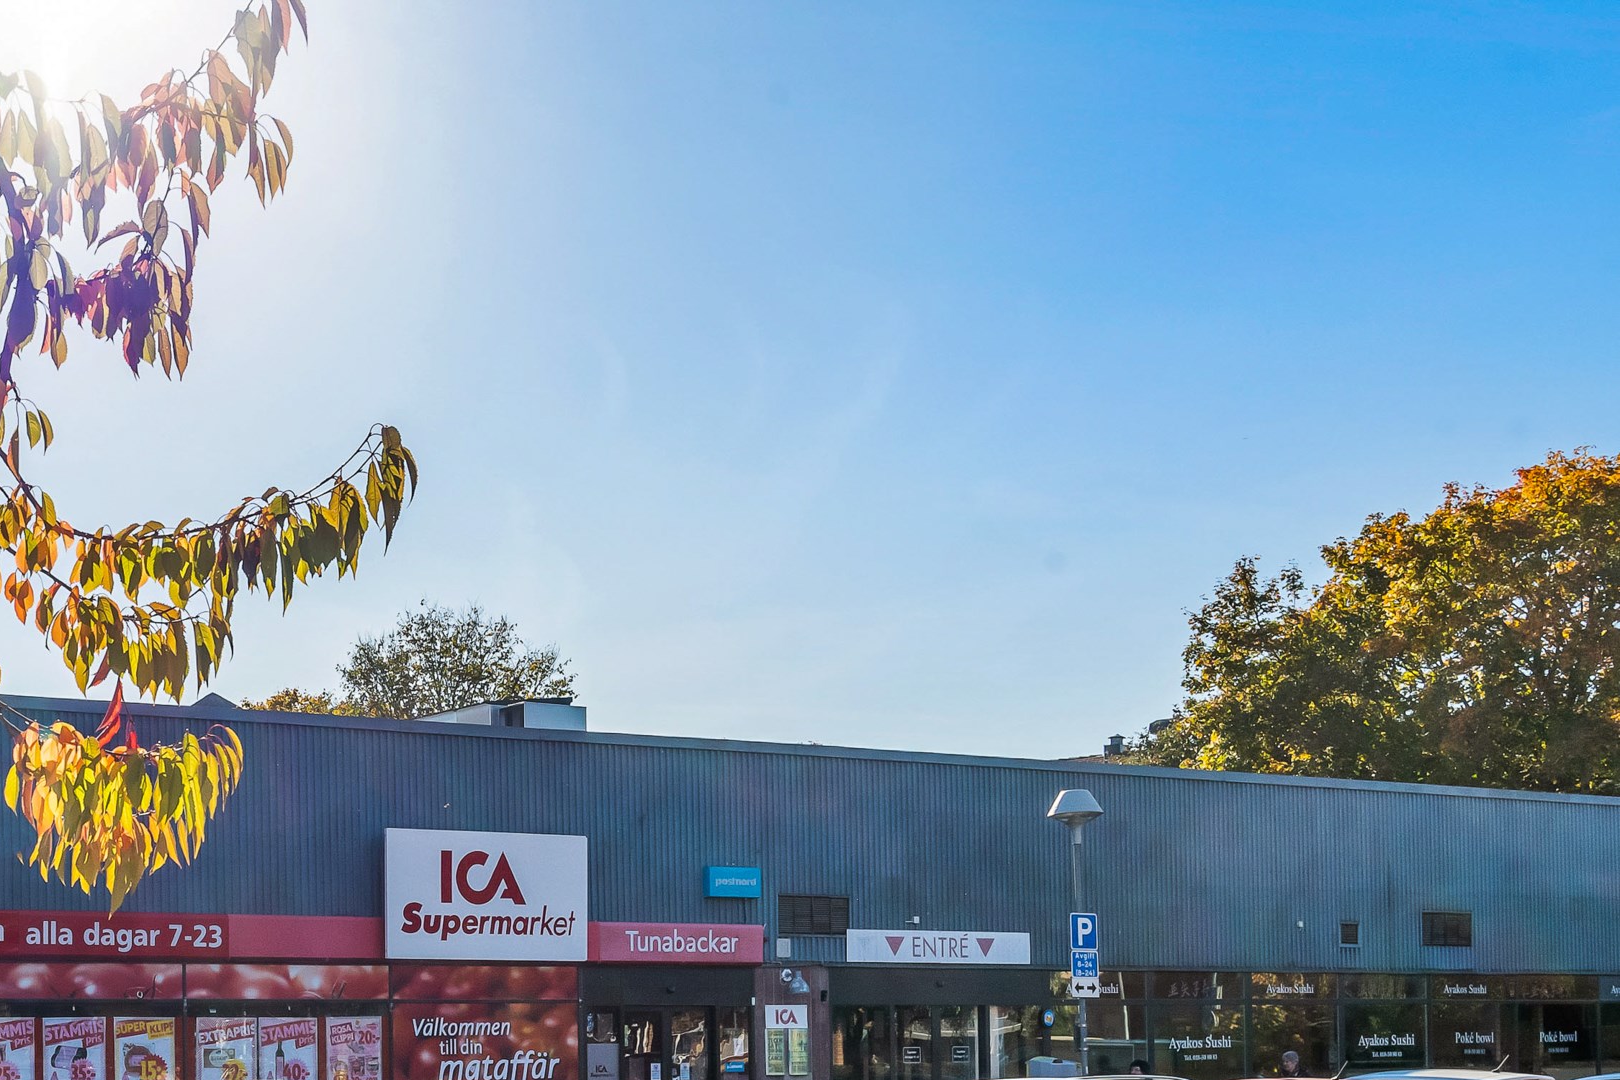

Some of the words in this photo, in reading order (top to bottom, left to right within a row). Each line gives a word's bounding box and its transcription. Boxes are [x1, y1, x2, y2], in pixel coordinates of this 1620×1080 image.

[441, 850, 526, 905] ICA
[715, 877, 757, 887] postnord
[401, 902, 576, 941] Supermarket
[26, 920, 73, 946] alla
[83, 921, 161, 953] dagar
[168, 923, 223, 949] 7-23
[1077, 917, 1093, 946] P
[625, 929, 739, 954] Tunabackar
[912, 934, 968, 958] ENTRÉ
[1293, 982, 1314, 994] Sushi
[775, 1008, 798, 1025] ICA
[45, 1020, 104, 1042] STAMMIS
[261, 1022, 315, 1041] STAMMIS
[412, 1017, 511, 1037] Välkommen
[439, 1038, 457, 1055] till
[460, 1038, 483, 1055] din
[1169, 1036, 1203, 1051] Ayakos
[1205, 1034, 1232, 1049] Sushi
[1358, 1034, 1389, 1049] Ayakos
[1391, 1033, 1415, 1046] Sushi
[1475, 1031, 1495, 1044] bowl
[1559, 1031, 1578, 1043] bowl
